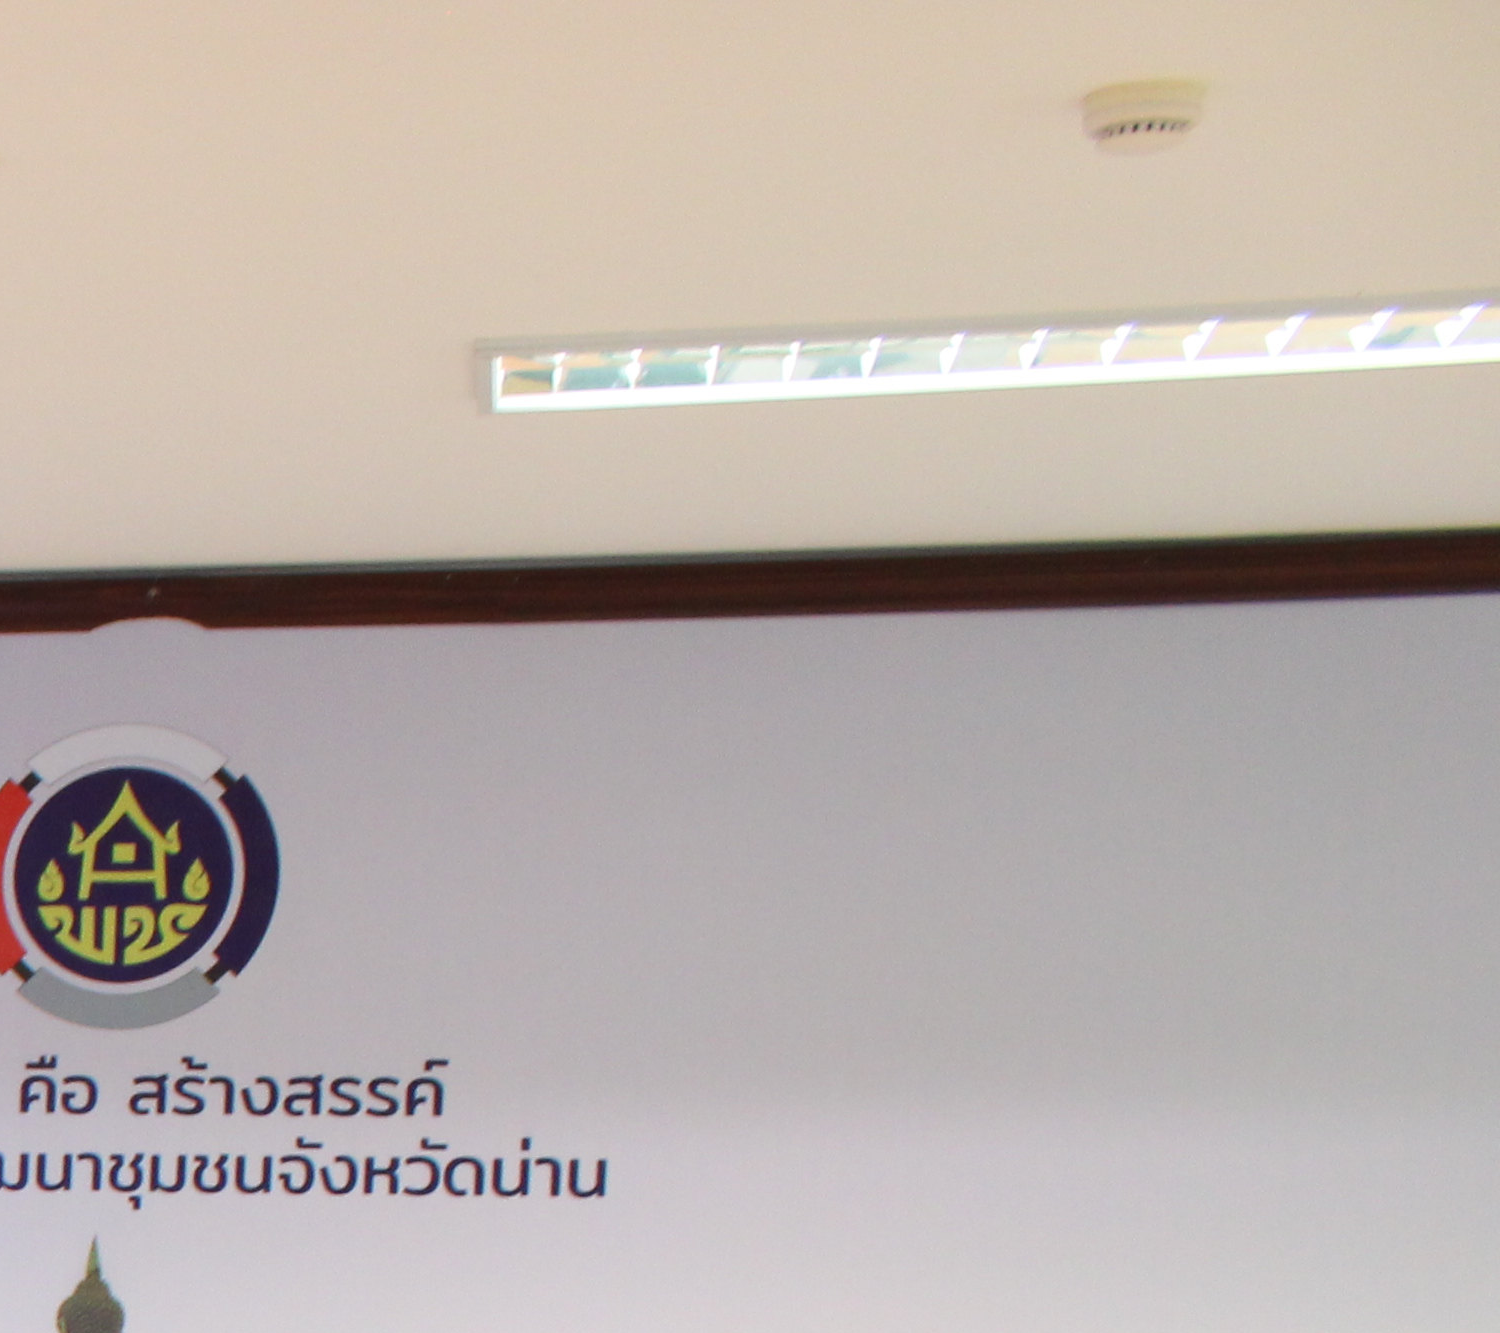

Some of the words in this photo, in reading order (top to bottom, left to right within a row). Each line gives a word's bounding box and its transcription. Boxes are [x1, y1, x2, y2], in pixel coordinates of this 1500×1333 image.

[20, 1053, 99, 1115] คือ
[129, 1055, 450, 1118] สร้างสรรค์
